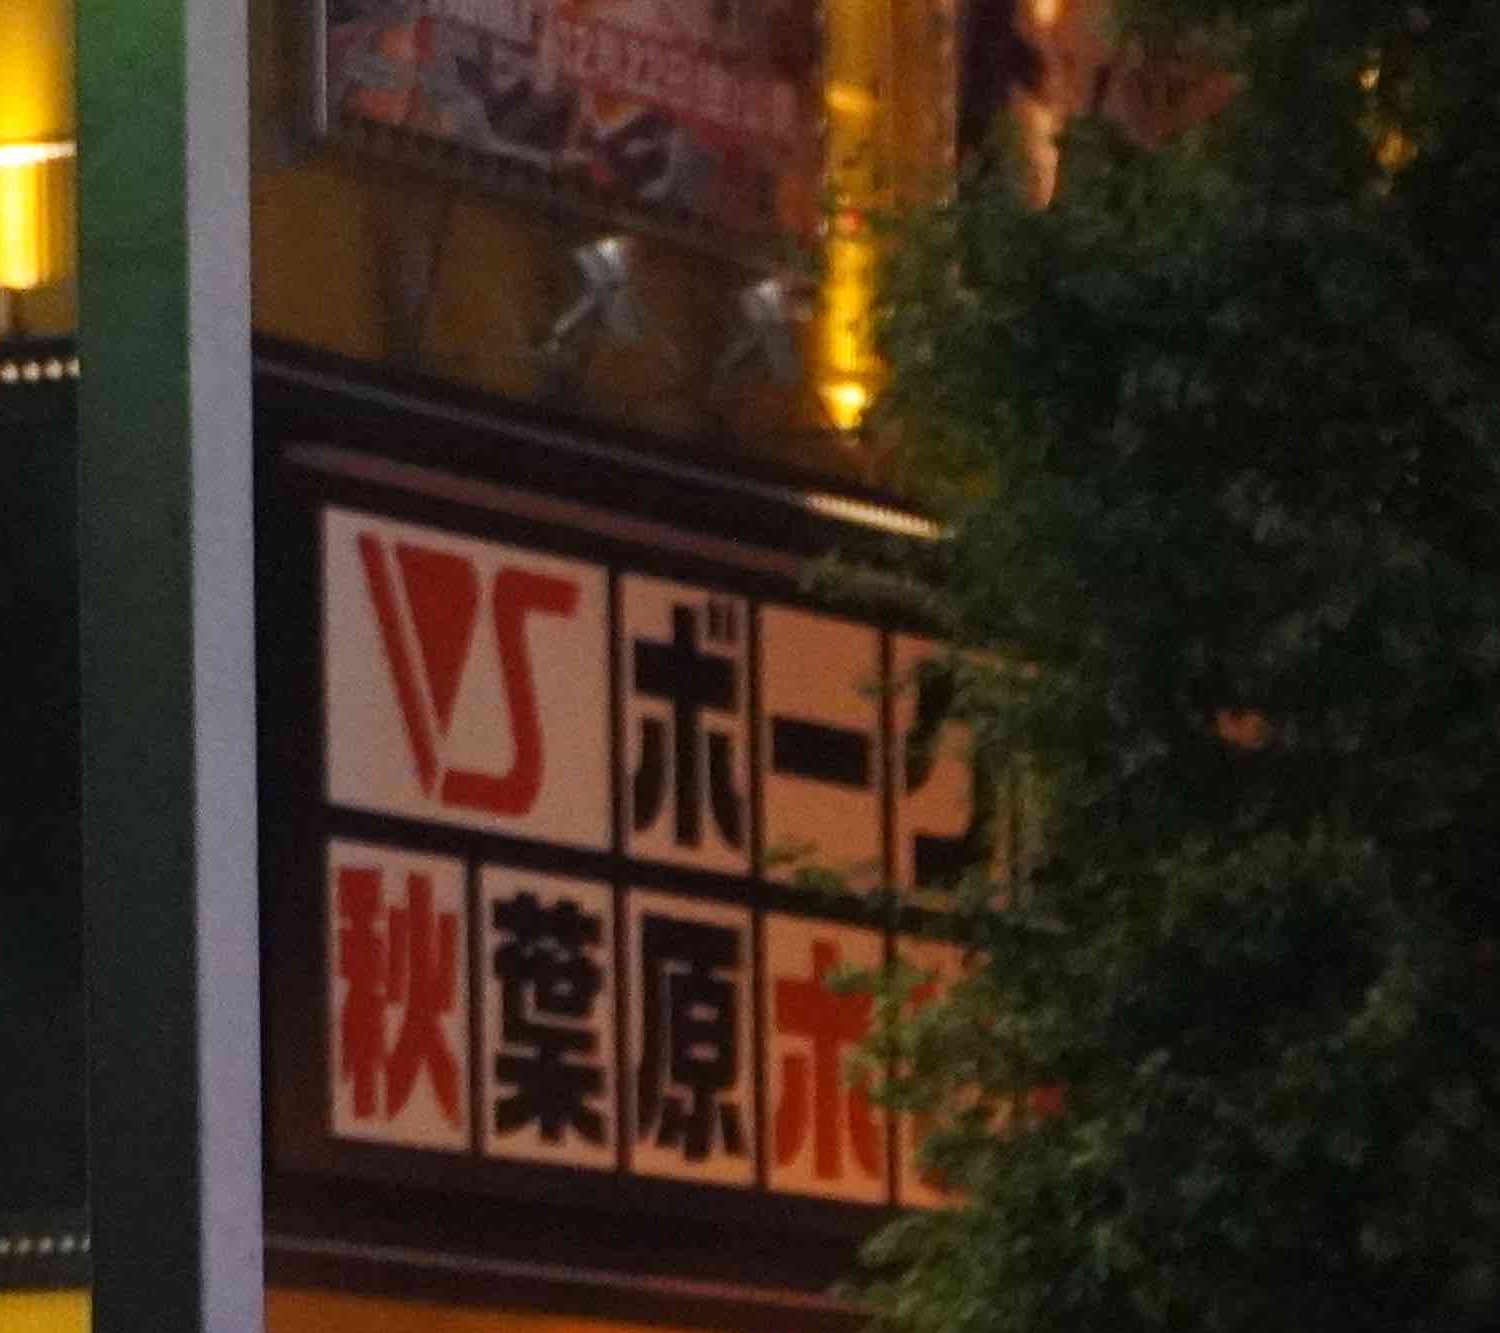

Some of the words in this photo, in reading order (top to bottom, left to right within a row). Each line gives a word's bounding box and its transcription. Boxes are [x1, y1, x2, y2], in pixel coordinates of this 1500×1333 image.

[357, 531, 581, 818] VS
[336, 866, 946, 1194] 秋葉原ホ
